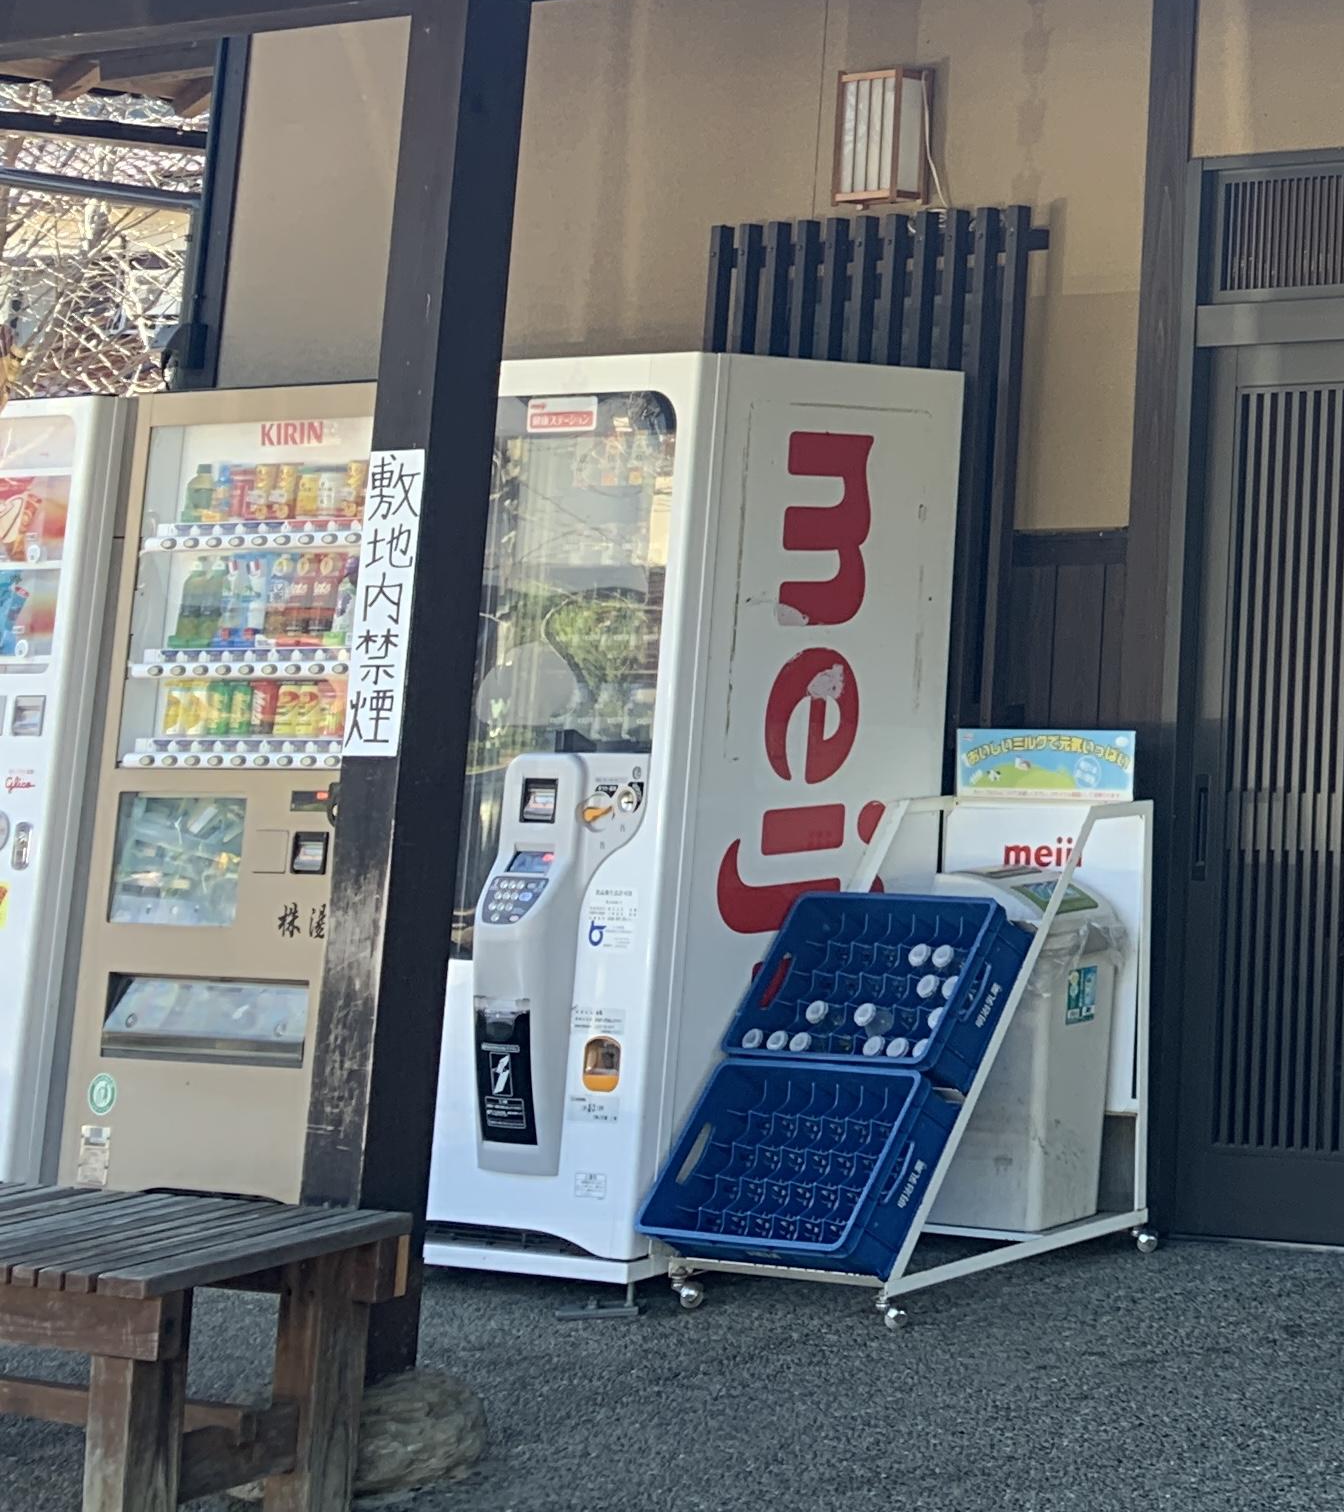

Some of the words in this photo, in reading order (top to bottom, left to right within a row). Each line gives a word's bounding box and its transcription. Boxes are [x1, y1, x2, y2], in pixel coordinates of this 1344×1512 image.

[260, 421, 325, 446] KIRIN
[345, 453, 421, 748] 敷地内禁煙
[717, 431, 886, 1008] meij
[5, 776, 36, 794] Glico
[1004, 836, 1082, 868] mei
